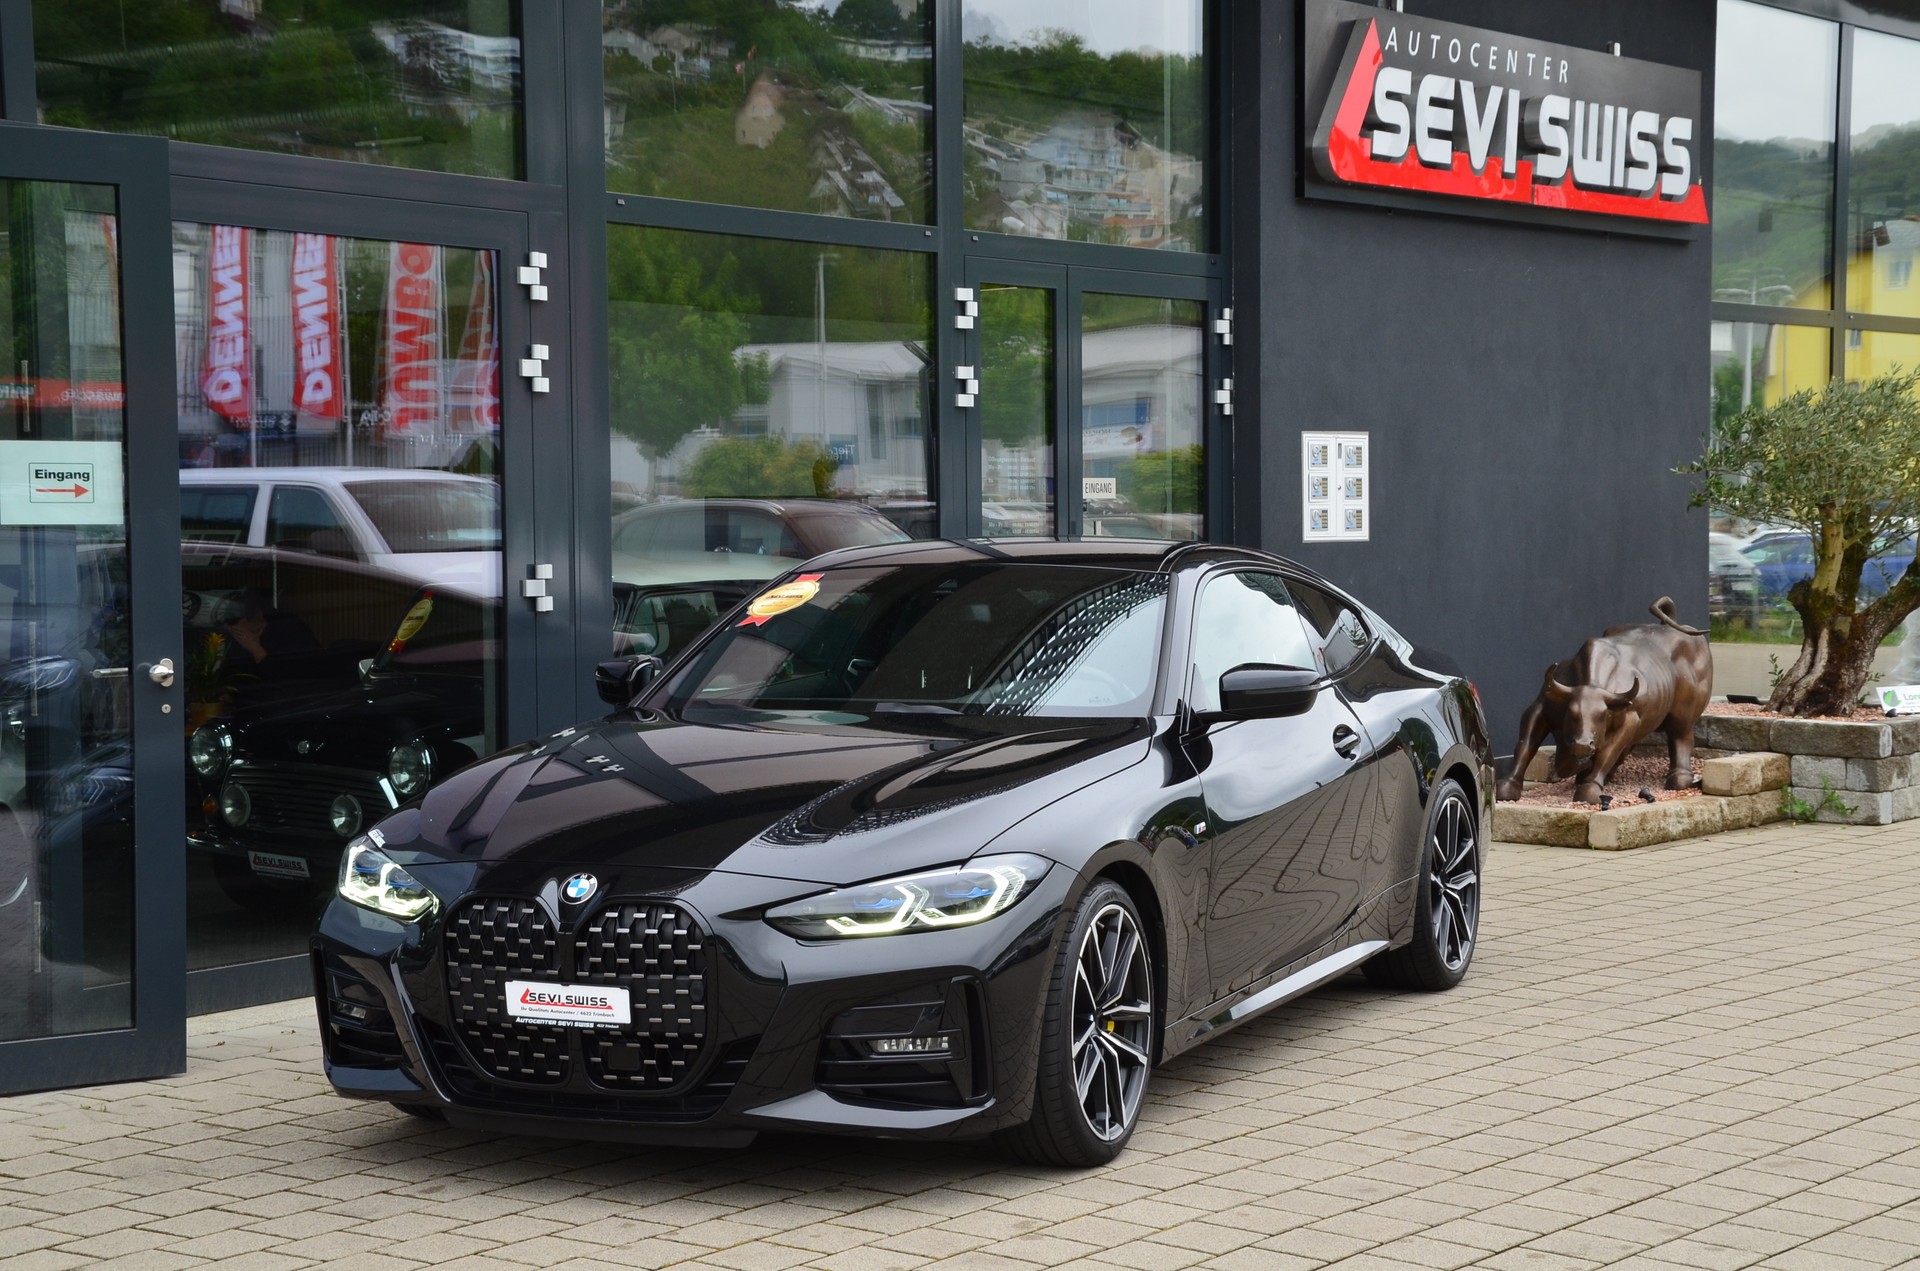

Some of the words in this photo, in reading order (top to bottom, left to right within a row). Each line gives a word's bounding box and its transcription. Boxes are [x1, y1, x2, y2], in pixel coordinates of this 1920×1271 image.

[1385, 26, 1569, 84] AUTOCENTER
[1370, 66, 1520, 174] SEVI
[1536, 94, 1692, 197] SWISS
[35, 469, 90, 482] Eingang
[1085, 482, 1112, 494] EINGANG
[529, 992, 561, 1004] SEVI
[565, 995, 608, 1007] SWISS
[557, 1020, 573, 1028] SEVI
[574, 1021, 594, 1029] SWISS
